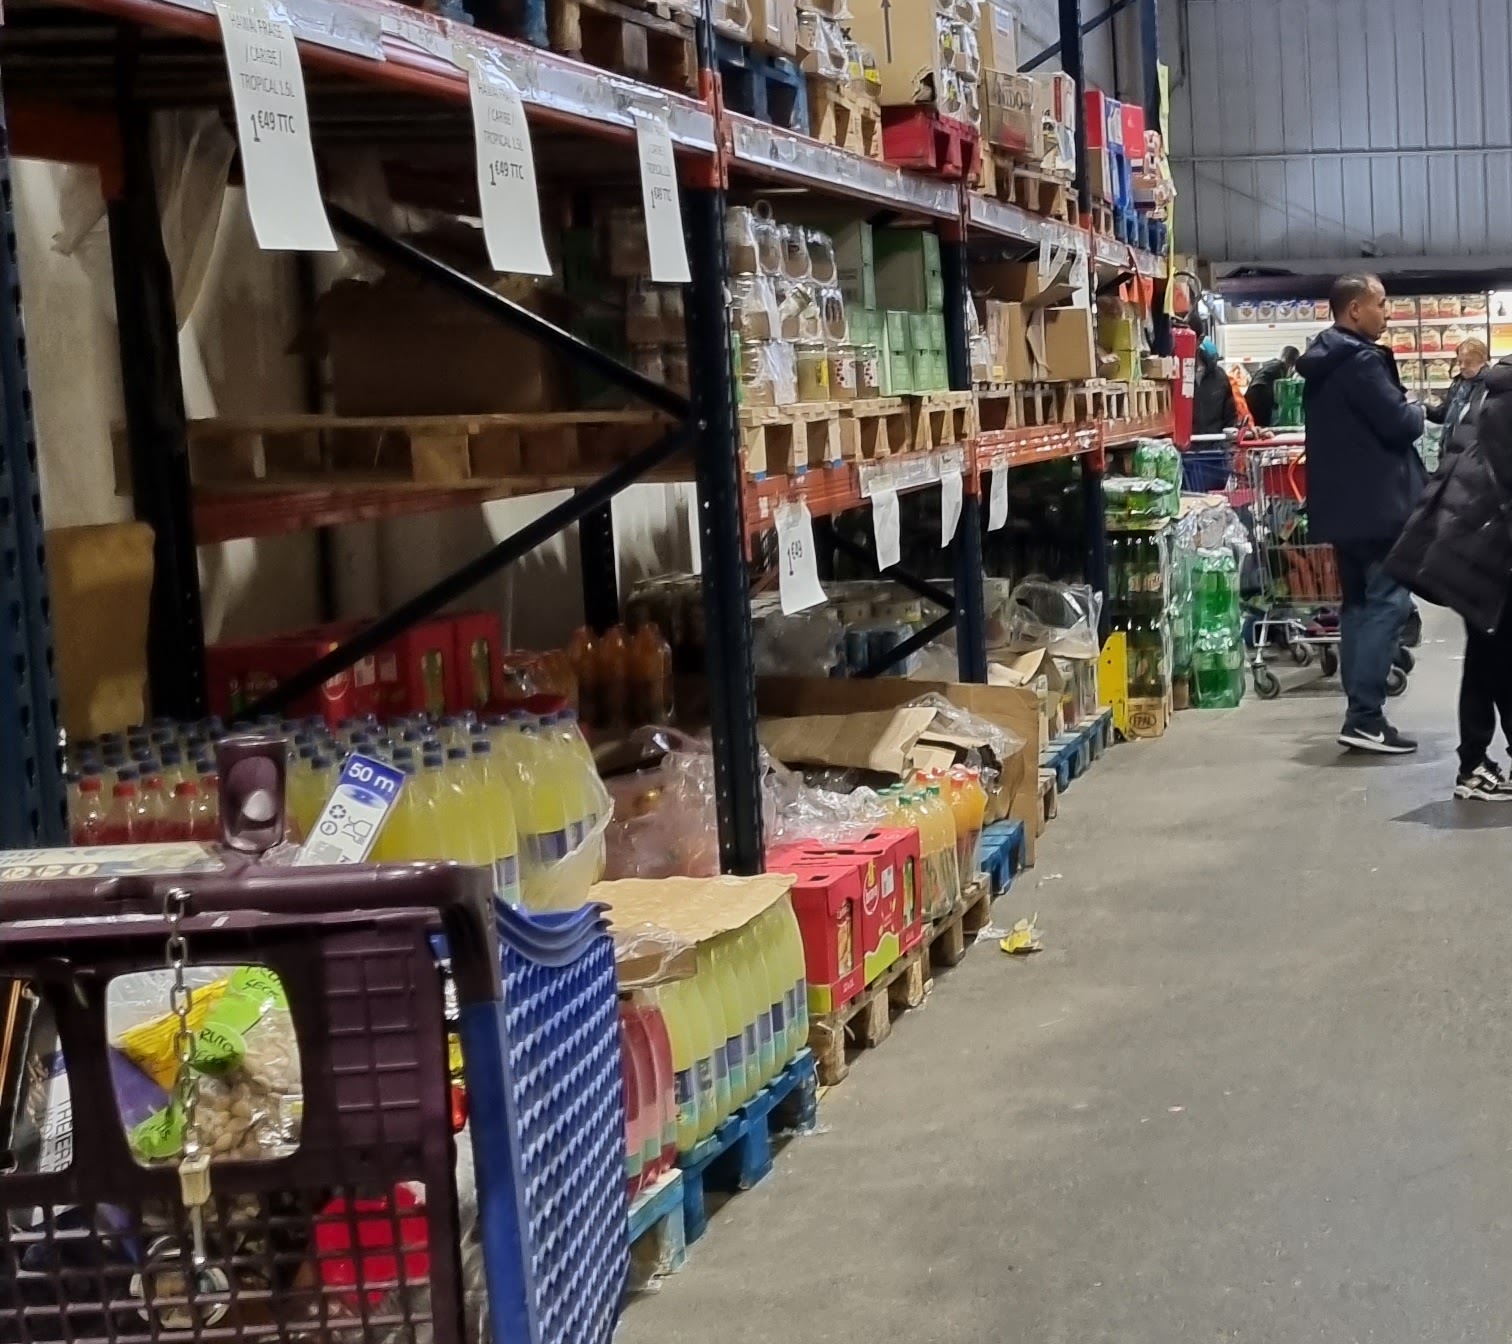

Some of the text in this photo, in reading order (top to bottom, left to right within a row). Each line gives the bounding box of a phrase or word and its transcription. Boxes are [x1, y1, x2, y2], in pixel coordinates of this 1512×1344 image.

[239, 73, 279, 95] TROPICAL
[277, 113, 296, 134] TTC
[510, 163, 524, 181] TTC
[348, 762, 395, 793] 50 m
